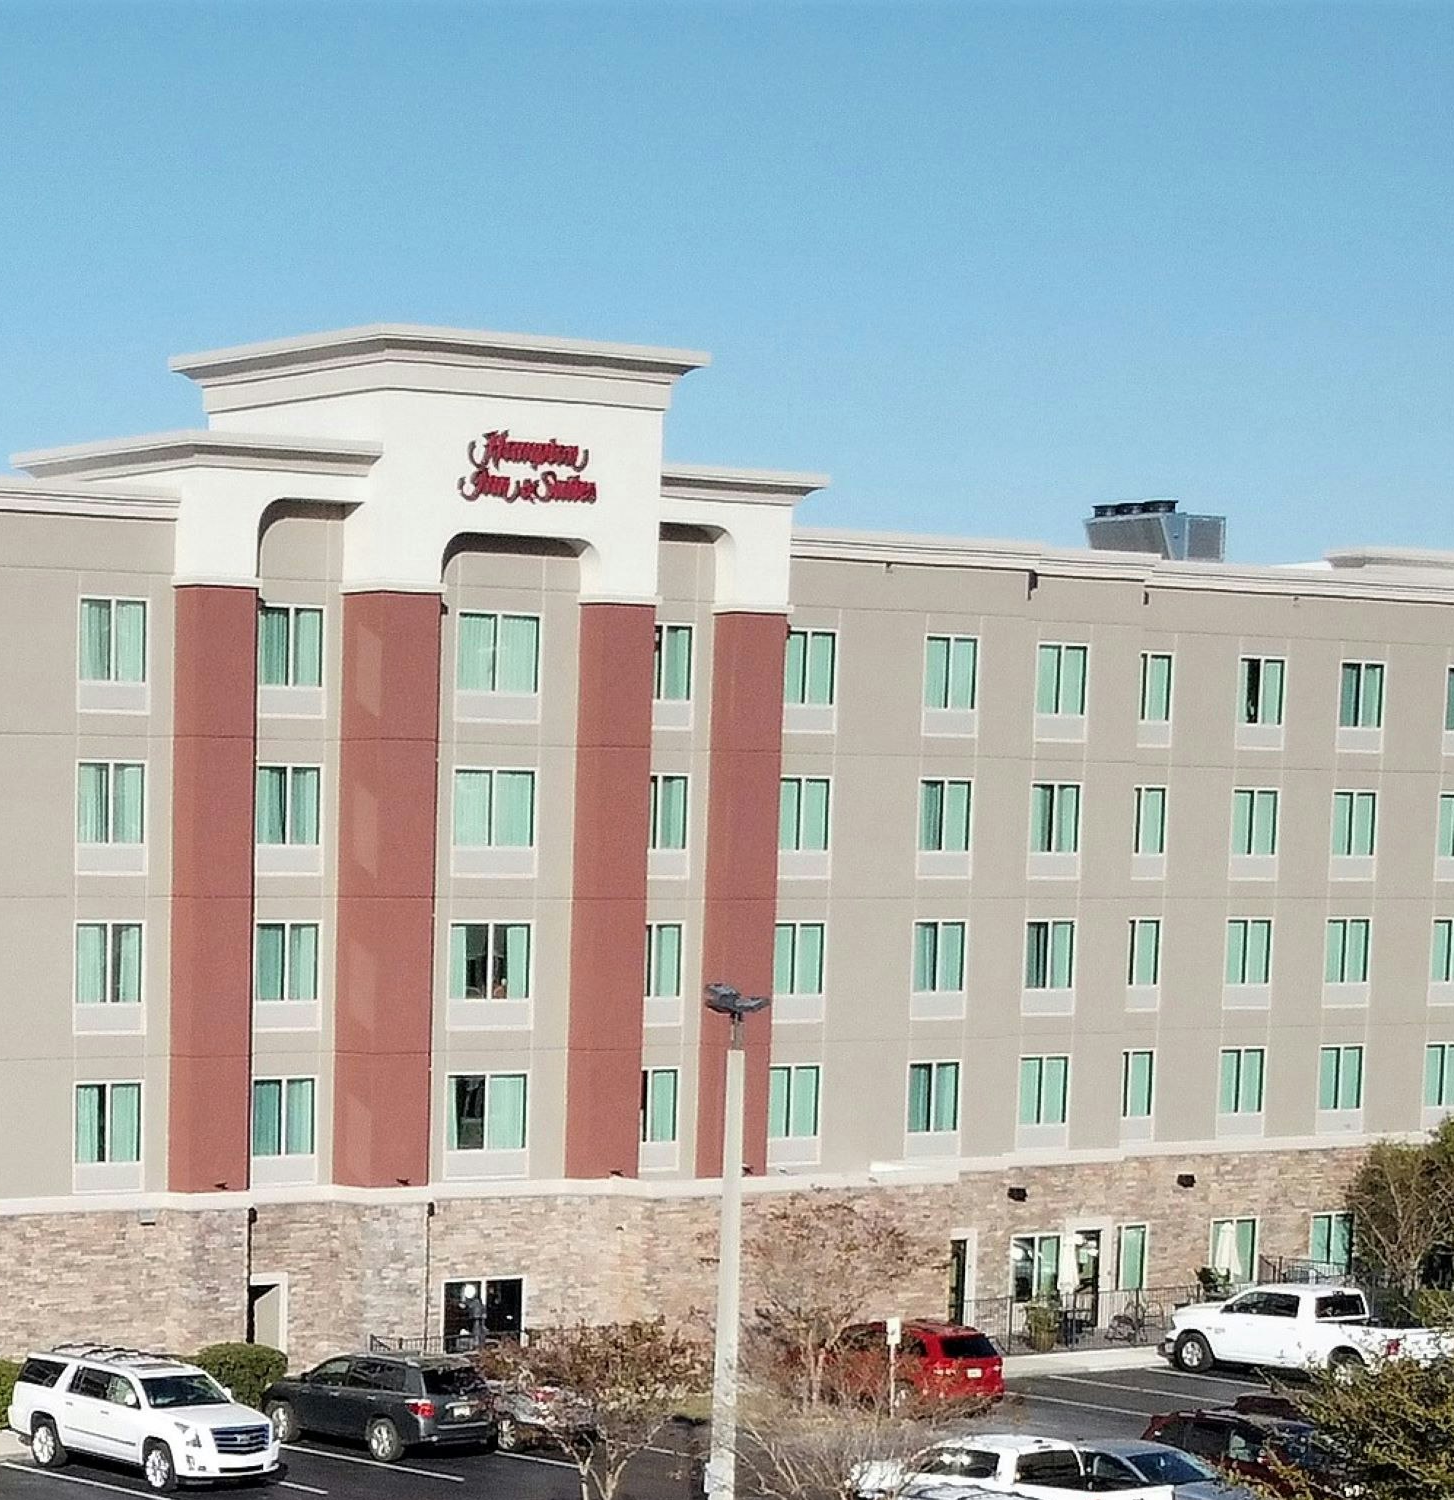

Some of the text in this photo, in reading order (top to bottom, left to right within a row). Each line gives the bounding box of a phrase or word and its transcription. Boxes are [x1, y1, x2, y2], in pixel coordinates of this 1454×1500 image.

[467, 429, 589, 472] Hampton
[457, 467, 520, 503] Inn
[534, 470, 597, 504] Suites
